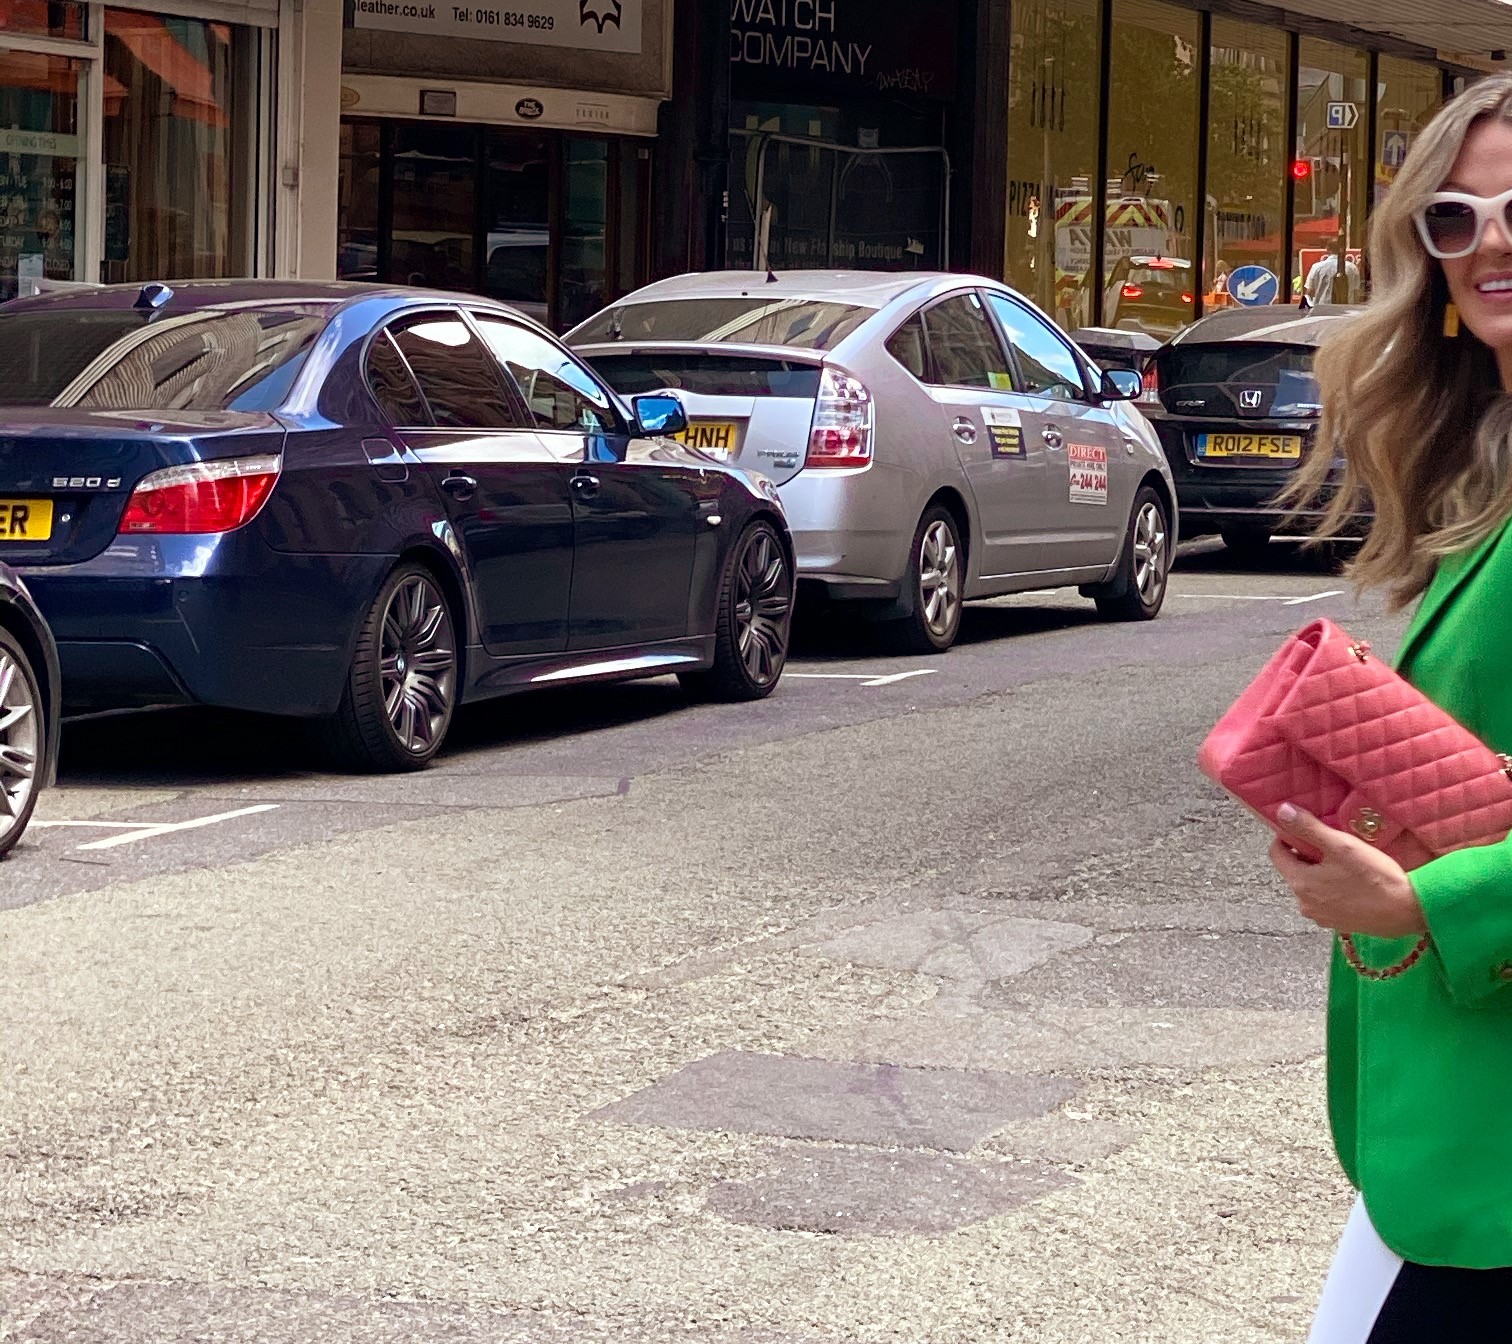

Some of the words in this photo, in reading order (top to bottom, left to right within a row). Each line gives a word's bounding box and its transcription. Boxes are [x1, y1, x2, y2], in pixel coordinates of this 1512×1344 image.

[452, 6, 473, 22] Tel:
[476, 9, 501, 26] 0161
[504, 12, 524, 28] 834
[527, 14, 555, 30] 9629
[730, 29, 872, 76] COMPANY
[1070, 445, 1105, 460] DIRECT
[1257, 437, 1294, 454] FSE
